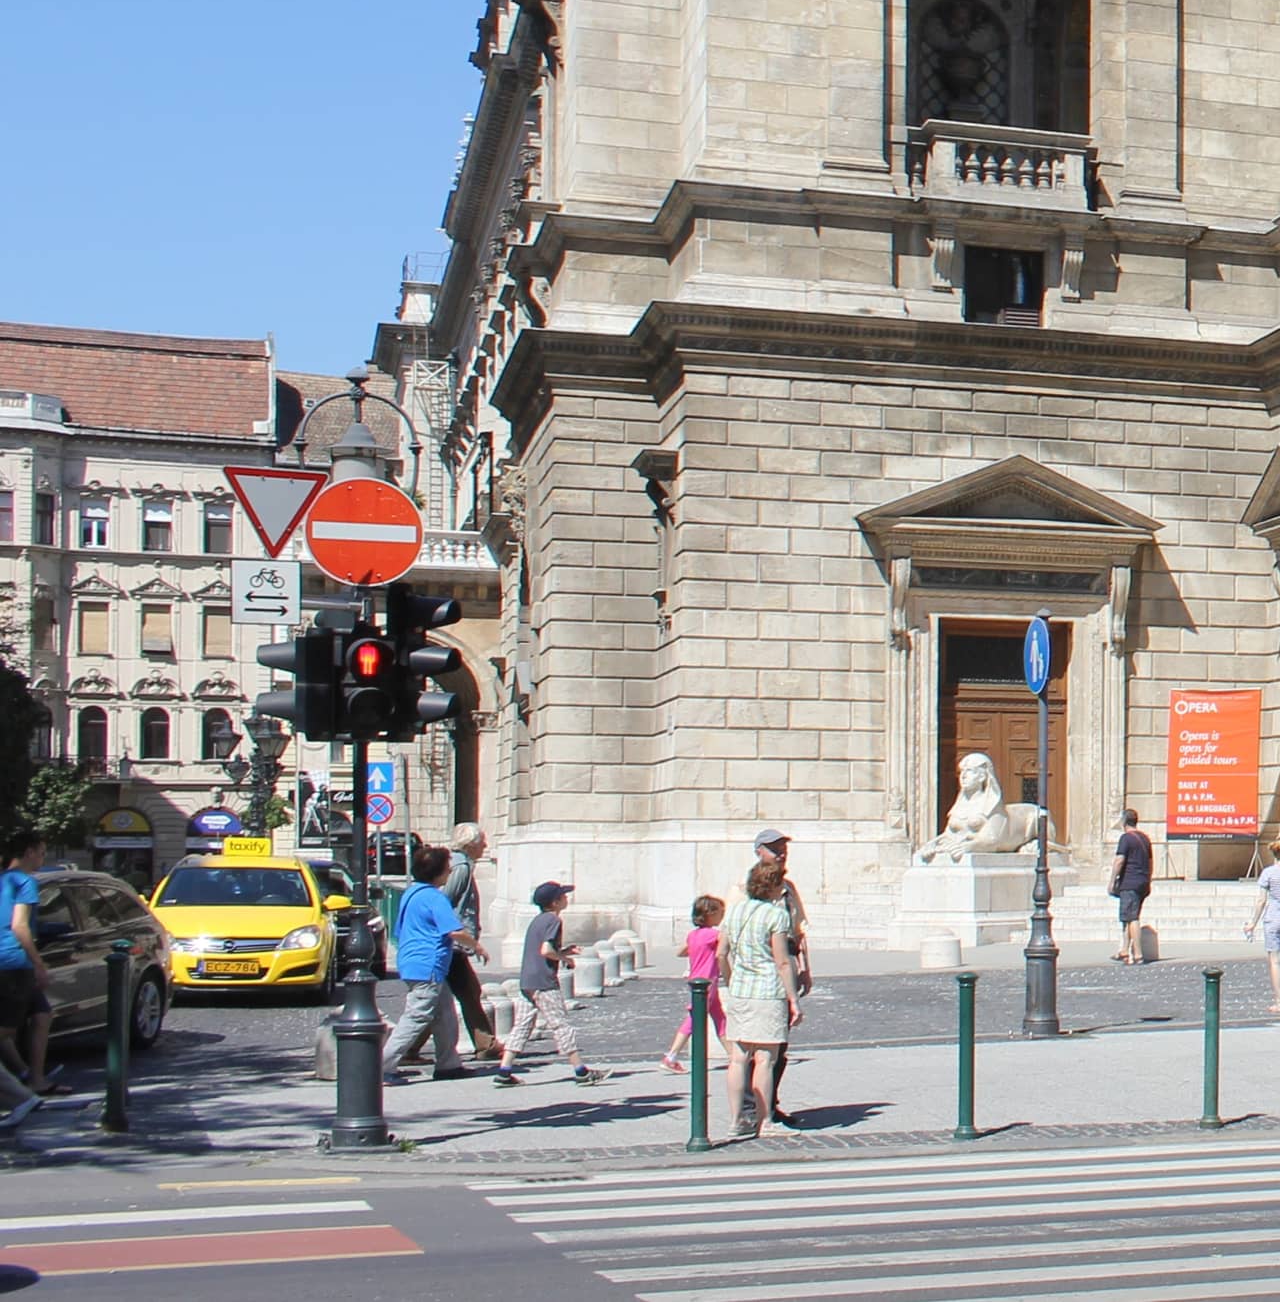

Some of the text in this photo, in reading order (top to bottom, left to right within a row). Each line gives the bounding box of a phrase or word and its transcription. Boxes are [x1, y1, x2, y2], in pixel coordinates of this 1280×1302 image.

[1174, 700, 1218, 715] OPERA
[1180, 729, 1220, 743] Opera is
[1179, 742, 1218, 756] open for
[1178, 754, 1238, 768] guided tours
[1178, 781, 1209, 790] DAILY AT
[1178, 804, 1186, 813] IN
[1195, 804, 1236, 814] LANGUAGES
[1176, 816, 1204, 825] ENGLISH
[1204, 816, 1213, 825] AT
[230, 841, 265, 854] taxify
